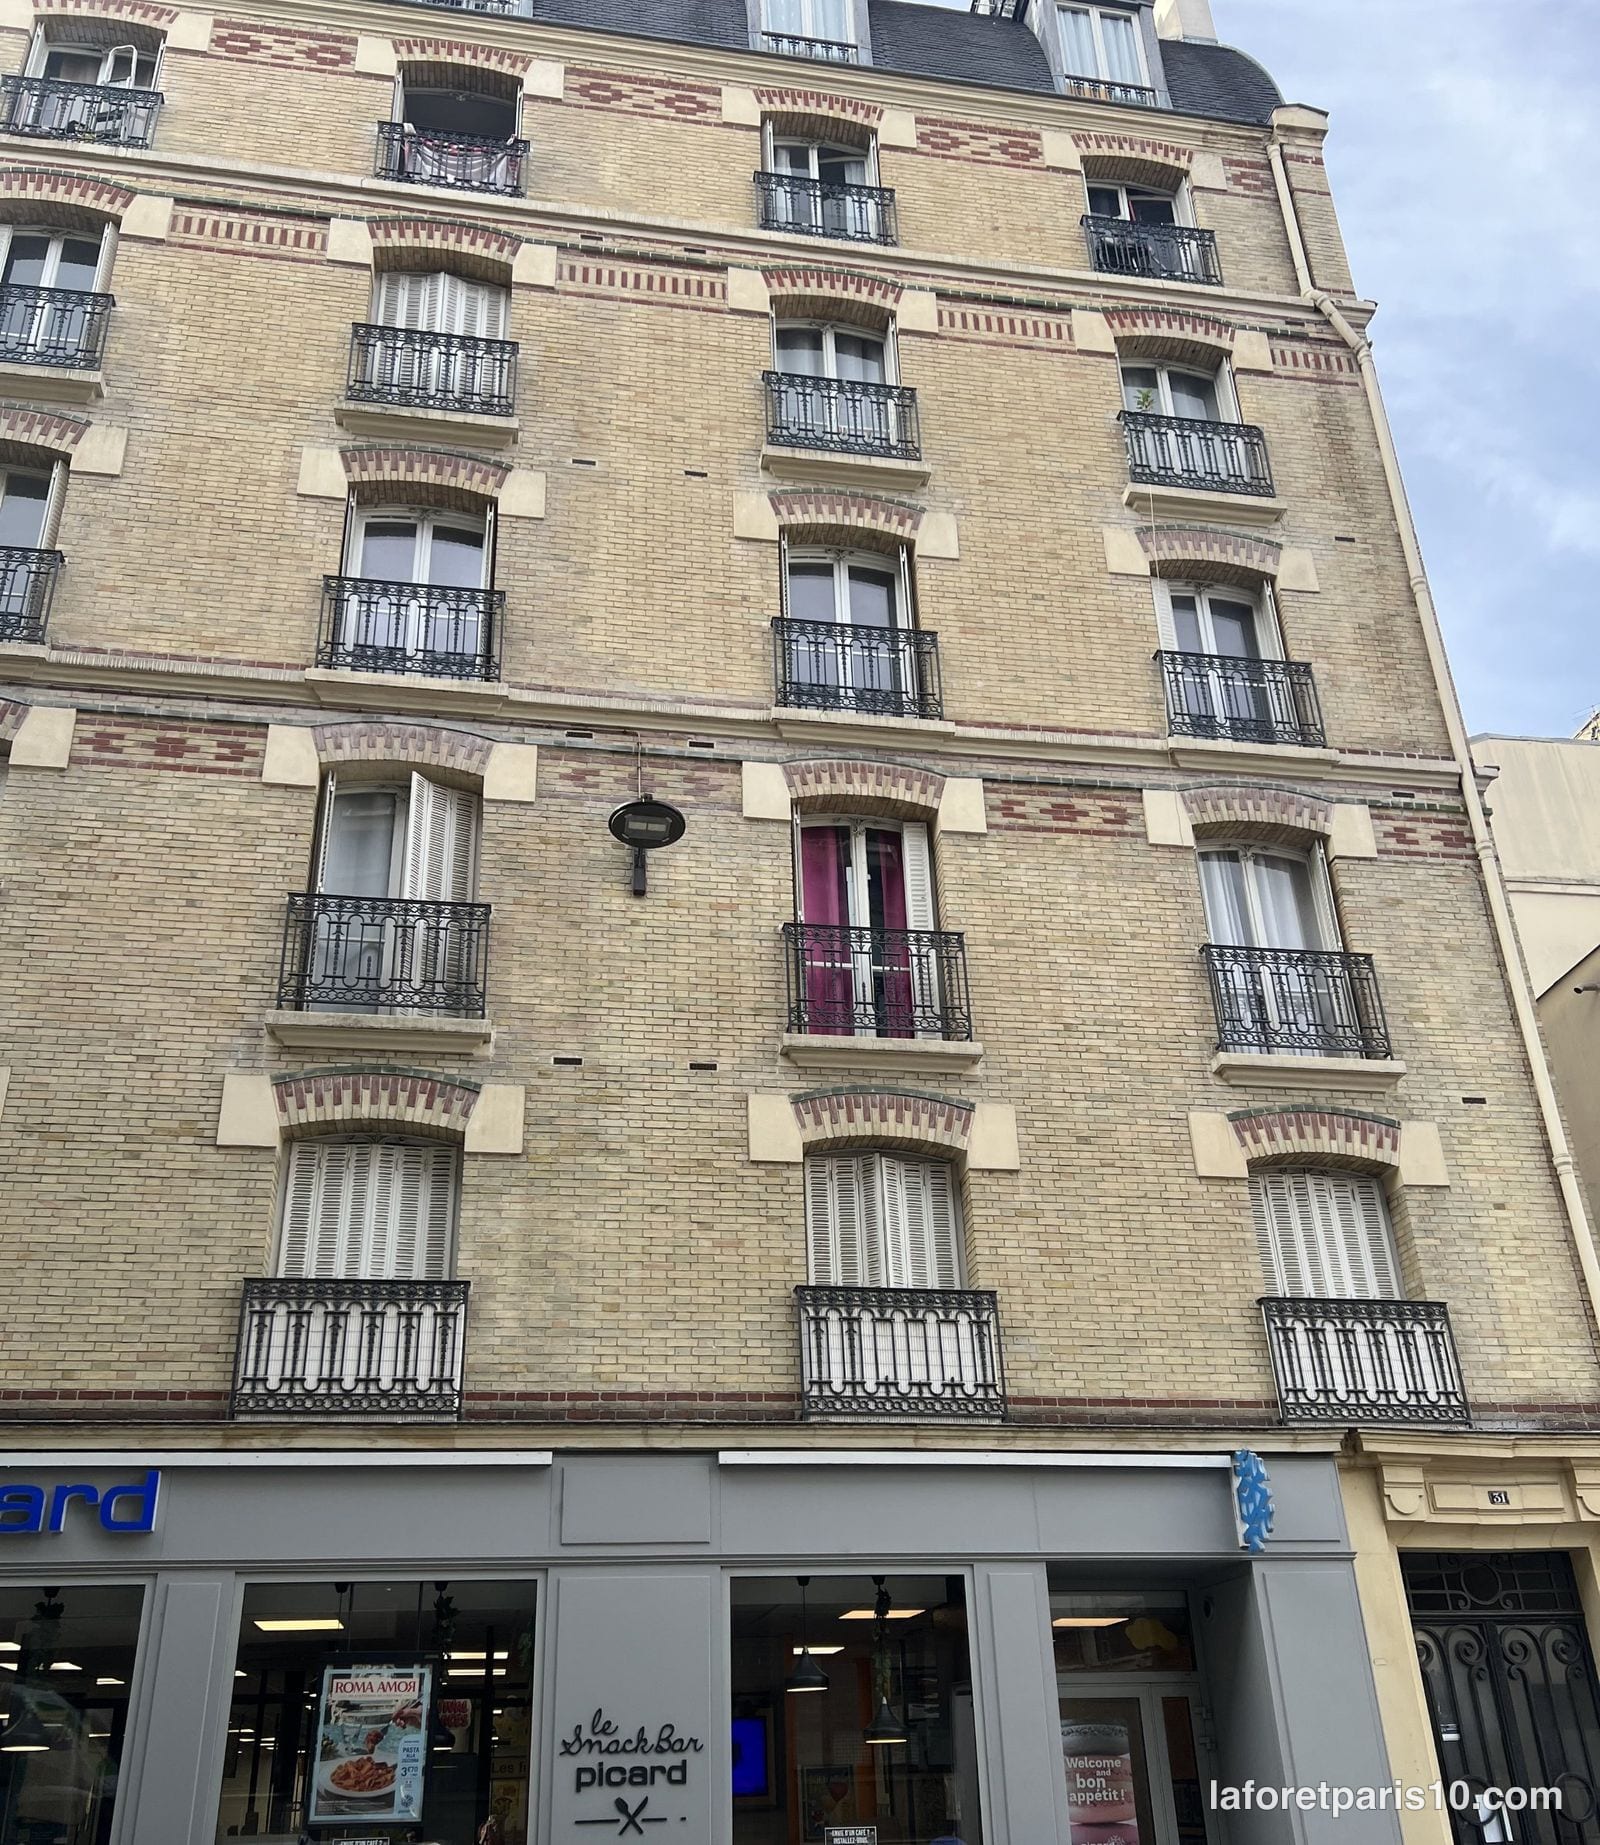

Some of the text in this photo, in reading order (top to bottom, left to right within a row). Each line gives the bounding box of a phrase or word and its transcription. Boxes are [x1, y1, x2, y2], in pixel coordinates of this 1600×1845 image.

[1493, 1492, 1506, 1503] 31
[335, 1681, 374, 1694] ROMA
[591, 1707, 619, 1736] le
[1065, 1756, 1121, 1769] Welcome
[575, 1759, 688, 1793] picard
[1096, 1769, 1112, 1777] and
[1075, 1773, 1107, 1789] bon
